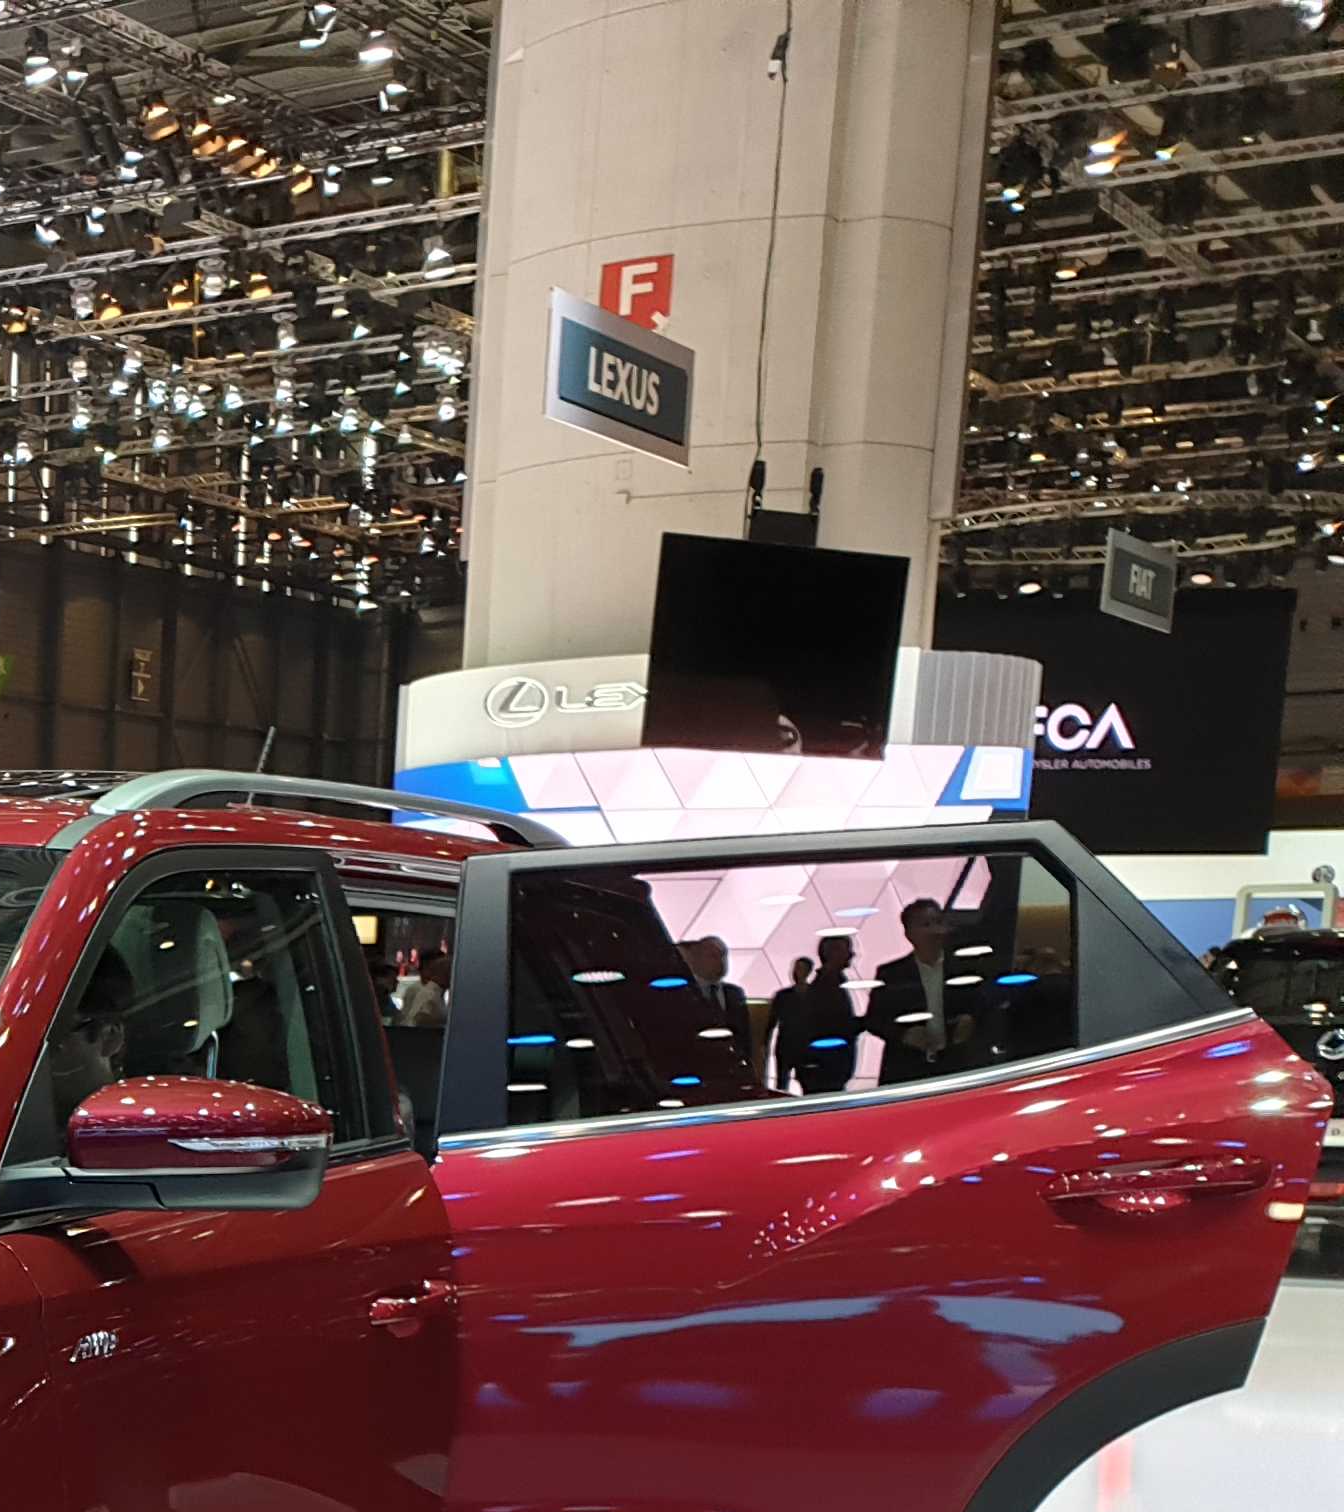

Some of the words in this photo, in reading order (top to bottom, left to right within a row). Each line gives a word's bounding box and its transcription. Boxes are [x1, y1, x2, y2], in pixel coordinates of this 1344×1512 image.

[619, 262, 658, 316] F
[588, 346, 660, 416] LEXUS
[1129, 563, 1156, 601] FIAT
